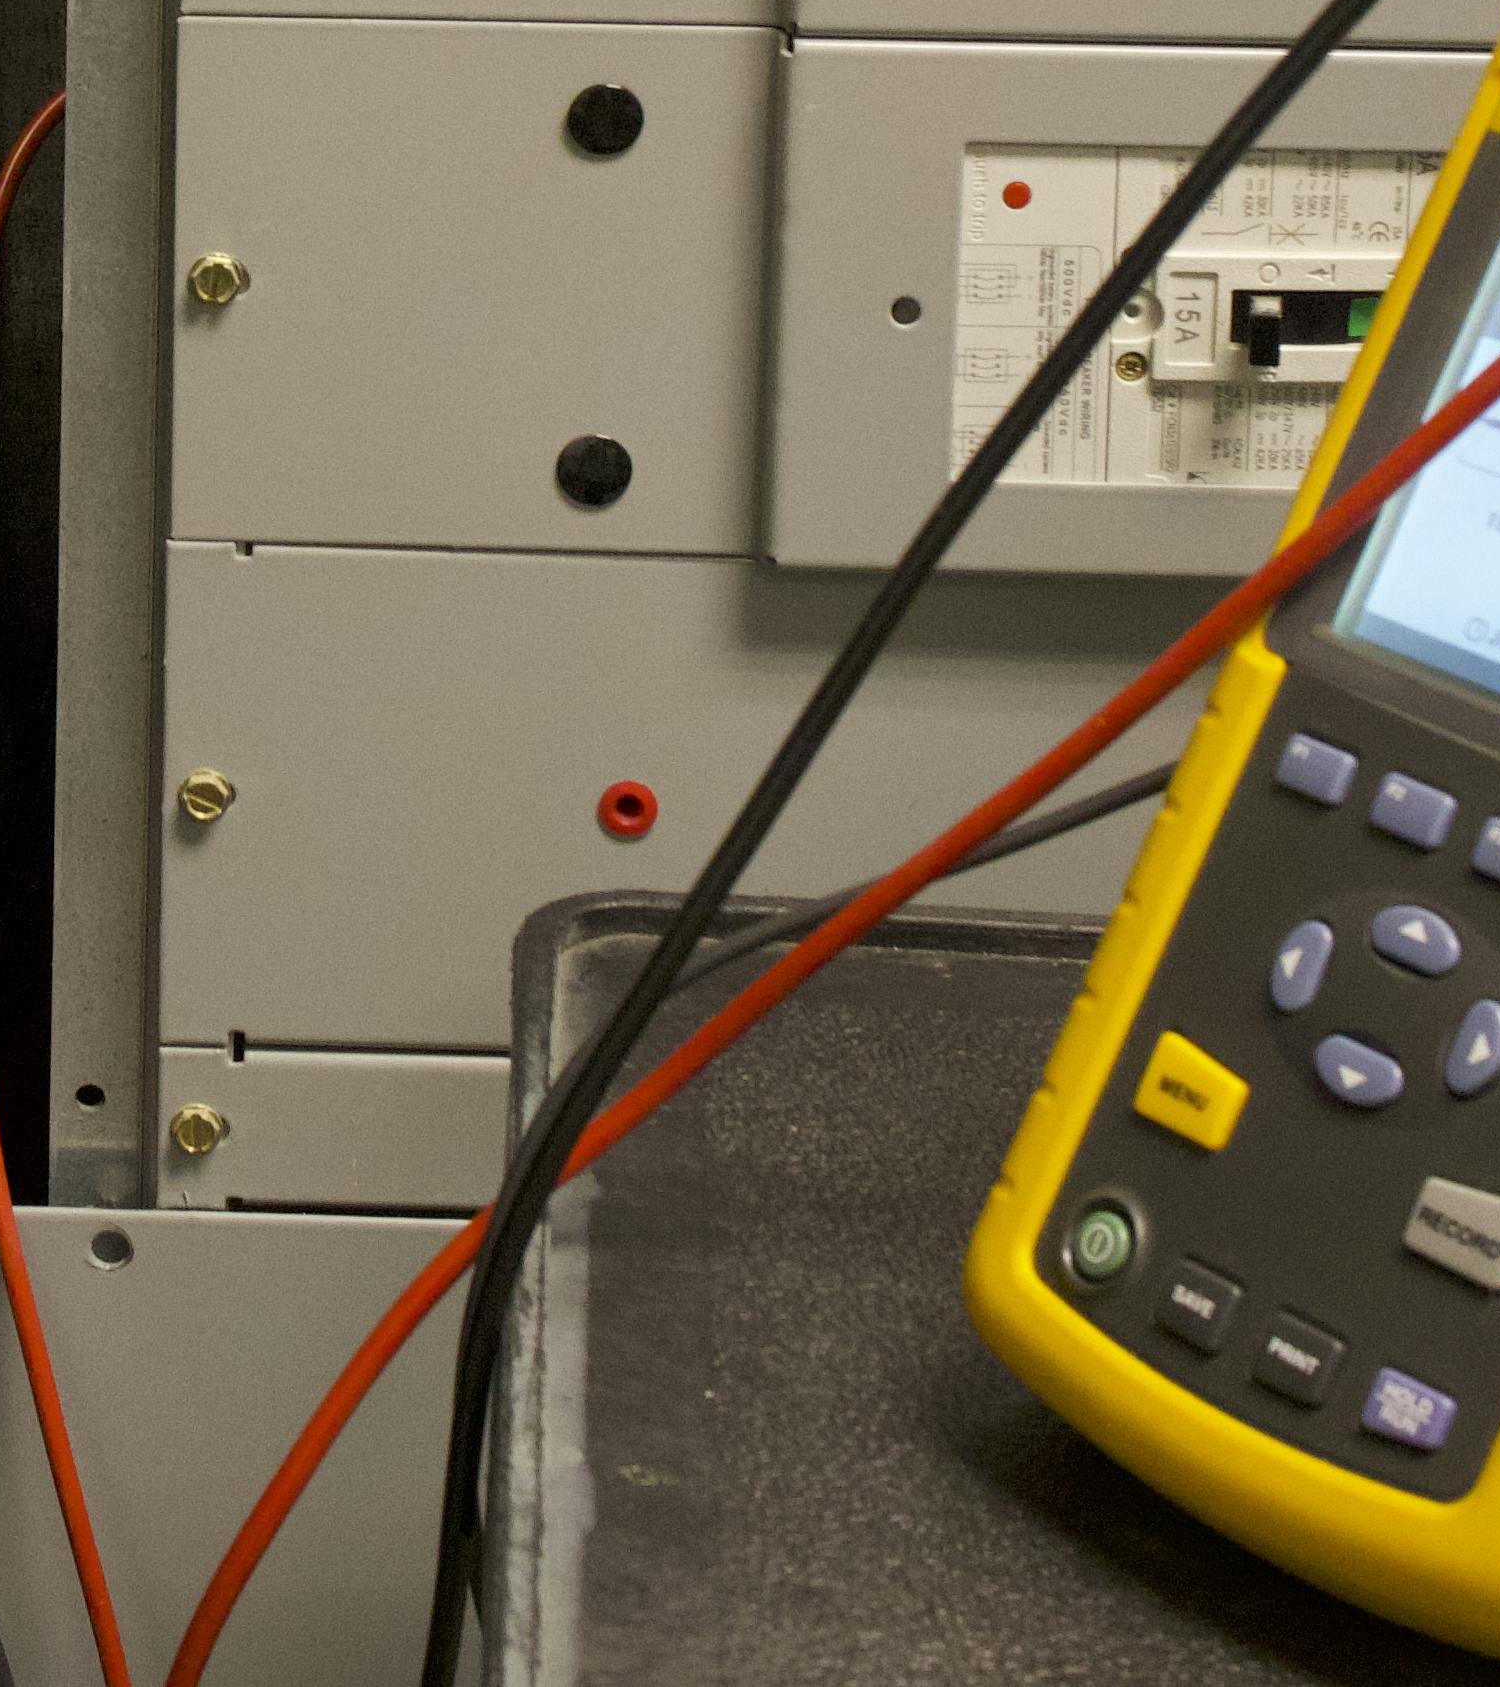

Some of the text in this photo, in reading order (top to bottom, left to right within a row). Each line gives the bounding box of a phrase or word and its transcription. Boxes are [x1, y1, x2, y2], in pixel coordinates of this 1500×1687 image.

[1173, 292, 1201, 344] 15A
[1078, 399, 1091, 441] WIRING
[1160, 1075, 1209, 1113] MENU
[1169, 1283, 1217, 1320] SAVE
[1266, 1335, 1321, 1375] PRINT
[1379, 1377, 1435, 1416] HOLD
[1378, 1403, 1420, 1438] RUN
